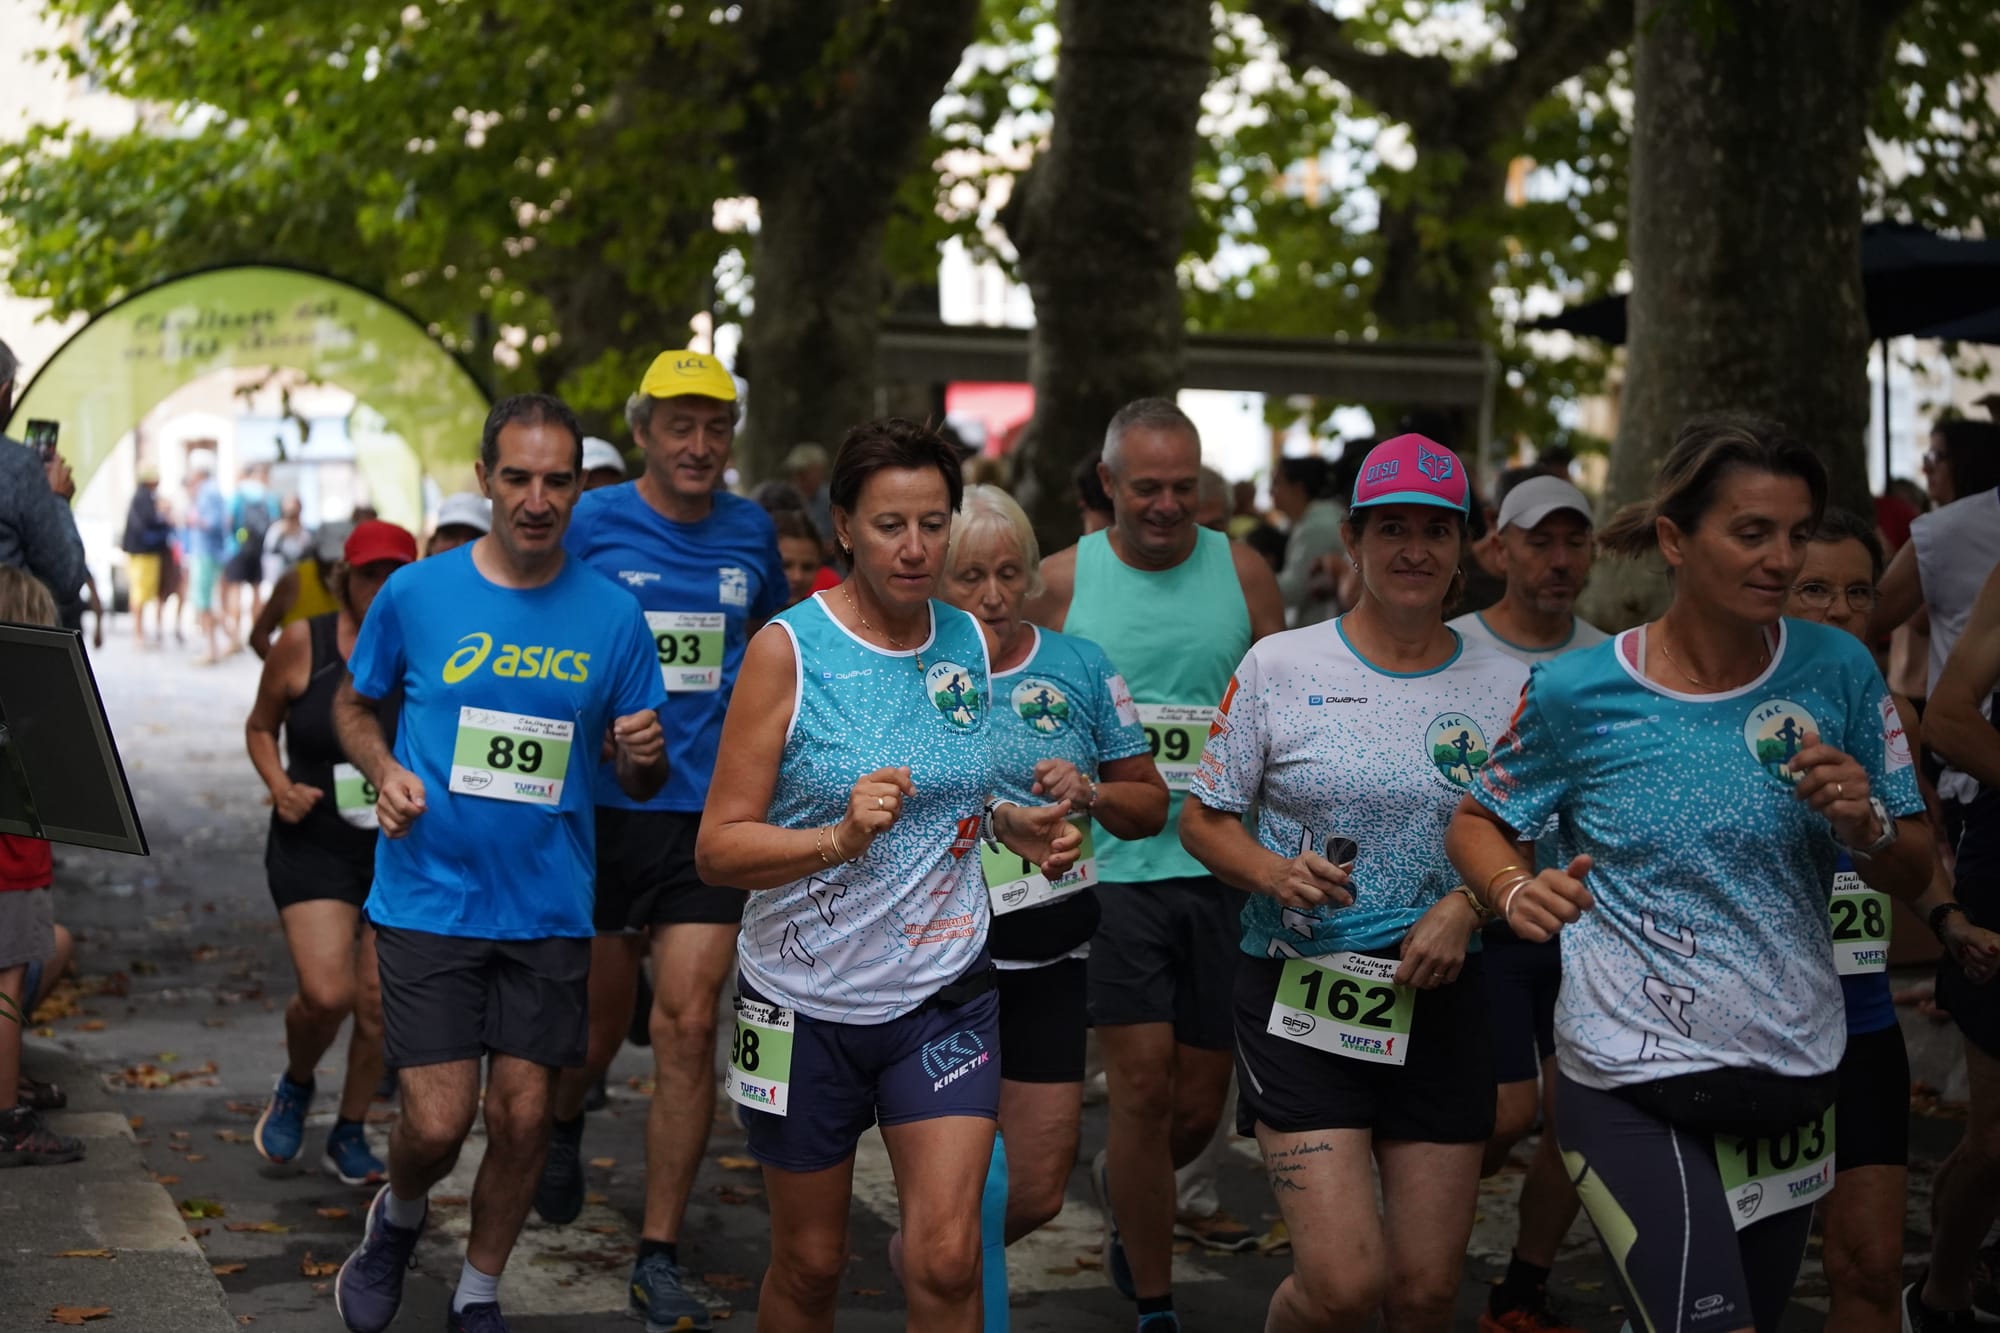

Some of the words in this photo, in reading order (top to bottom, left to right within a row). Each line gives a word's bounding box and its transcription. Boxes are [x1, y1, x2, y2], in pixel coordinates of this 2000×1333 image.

[676, 358, 708, 369] LCL
[1366, 459, 1400, 481] OTSO
[656, 633, 701, 665] 93
[492, 644, 591, 683] asics
[932, 666, 949, 680] TAC
[1325, 696, 1368, 704] owayo
[1757, 704, 1782, 722] TAC
[1438, 718, 1462, 731] TAC
[487, 735, 543, 774] 89
[514, 781, 546, 793] TUFF'S
[1001, 887, 1026, 903] BFP
[1342, 964, 1374, 976] vallées
[1348, 955, 1393, 972] Challenge
[1299, 969, 1396, 1029] 162
[742, 1001, 770, 1016] hallenge
[1282, 1015, 1311, 1031] BFP
[732, 1021, 760, 1072] 98
[1339, 1032, 1383, 1049] TUFF'S
[1341, 1040, 1386, 1056] Aventure
[933, 1050, 990, 1093] KINETIK
[740, 1081, 767, 1097] TUFF'S
[741, 1089, 770, 1105] Aventure
[1735, 1112, 1825, 1178] 103
[1788, 1172, 1822, 1193] TUFF'S
[1737, 1192, 1760, 1212] BFP
